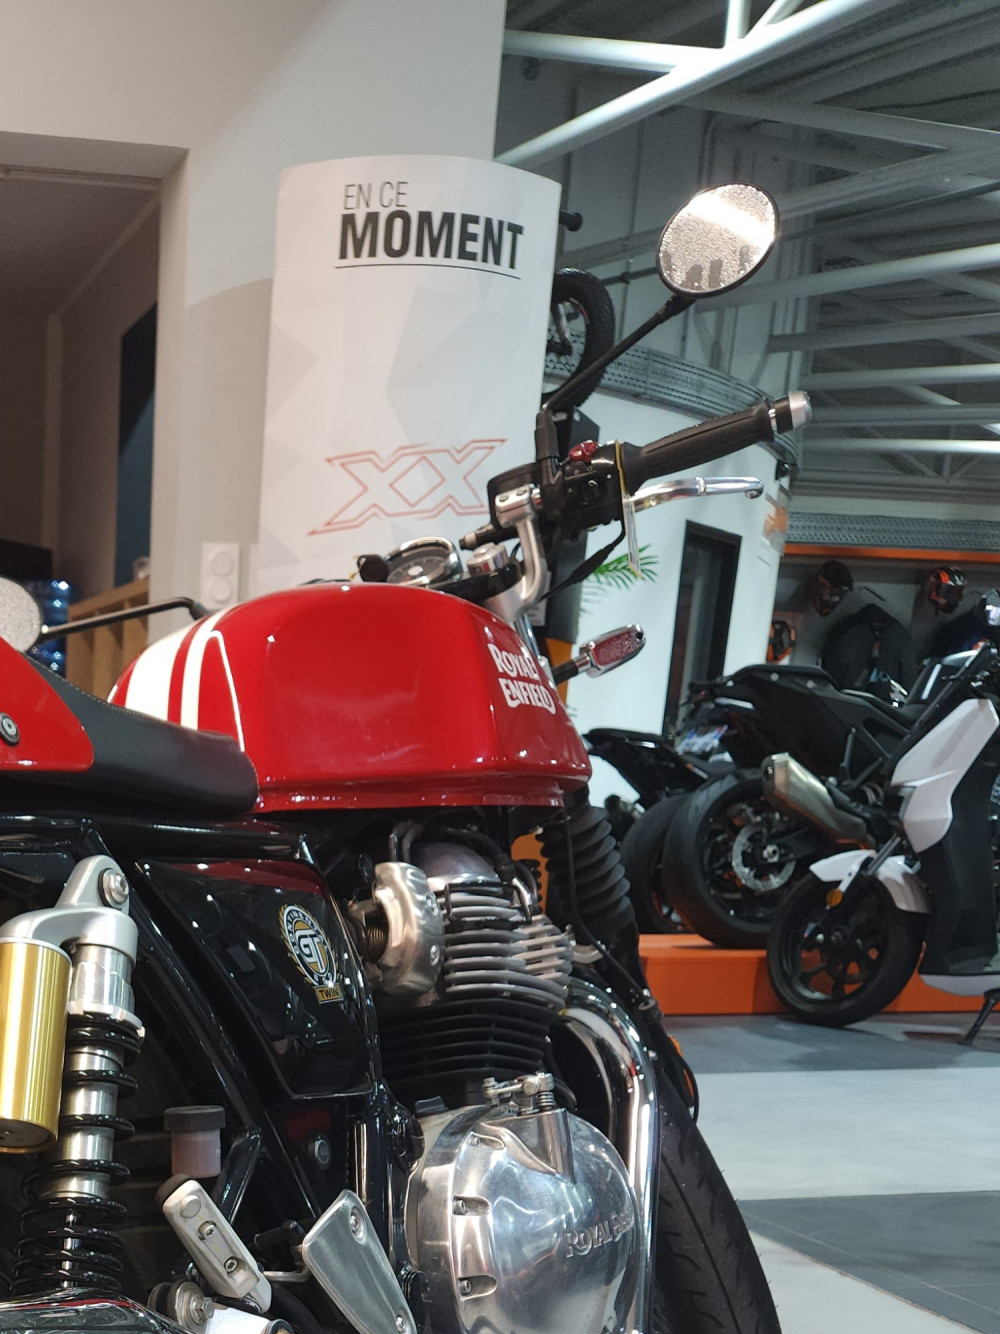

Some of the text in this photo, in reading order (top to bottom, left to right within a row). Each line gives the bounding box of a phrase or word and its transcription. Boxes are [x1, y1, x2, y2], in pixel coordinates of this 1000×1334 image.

[344, 181, 409, 210] EN CE
[339, 209, 524, 270] MOMENT
[487, 643, 541, 680] ROYAL
[498, 677, 556, 714] ENFIELD
[295, 929, 327, 974] GT
[319, 988, 340, 999] TWIN
[562, 1221, 614, 1258] ROYAL
